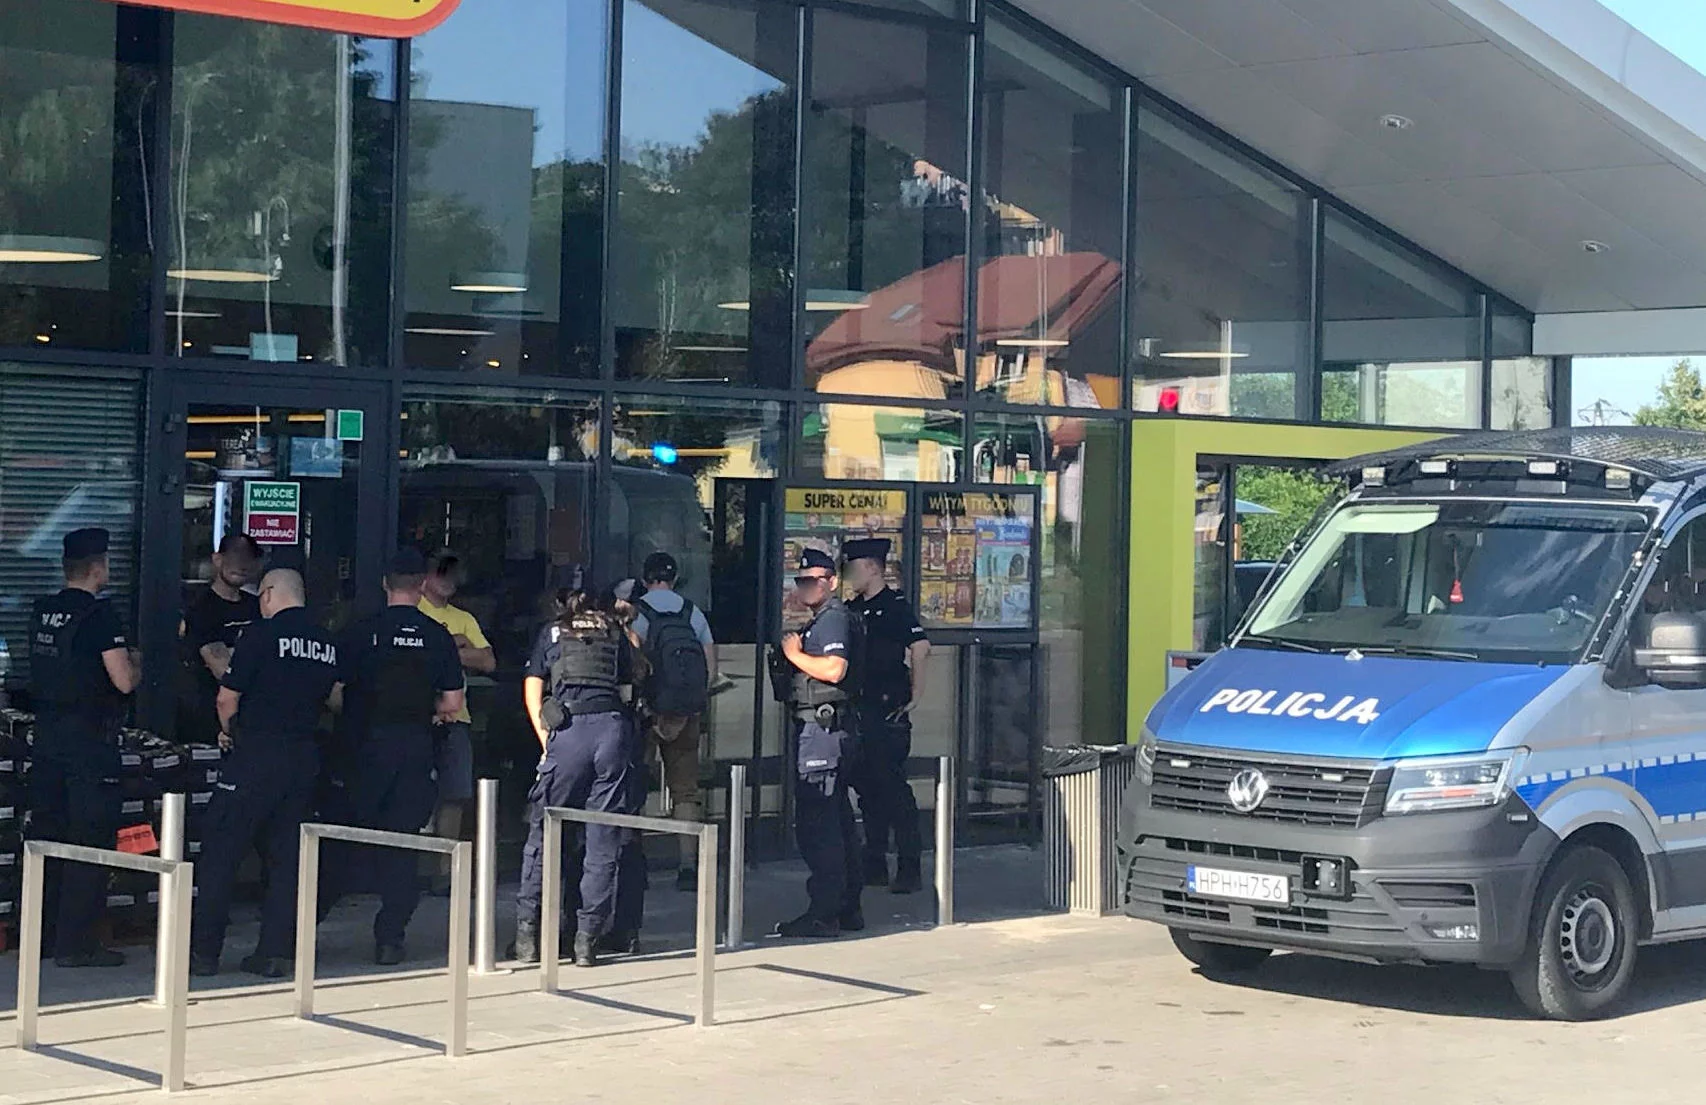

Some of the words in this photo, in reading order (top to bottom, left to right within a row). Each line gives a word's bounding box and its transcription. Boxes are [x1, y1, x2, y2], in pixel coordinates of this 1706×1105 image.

[804, 493, 845, 509] SUPER
[279, 637, 337, 666] POLICJA
[393, 636, 424, 647] POLICJA
[1200, 688, 1381, 725] POLICJA
[1199, 871, 1232, 894] HPH
[1238, 875, 1283, 900] H756
